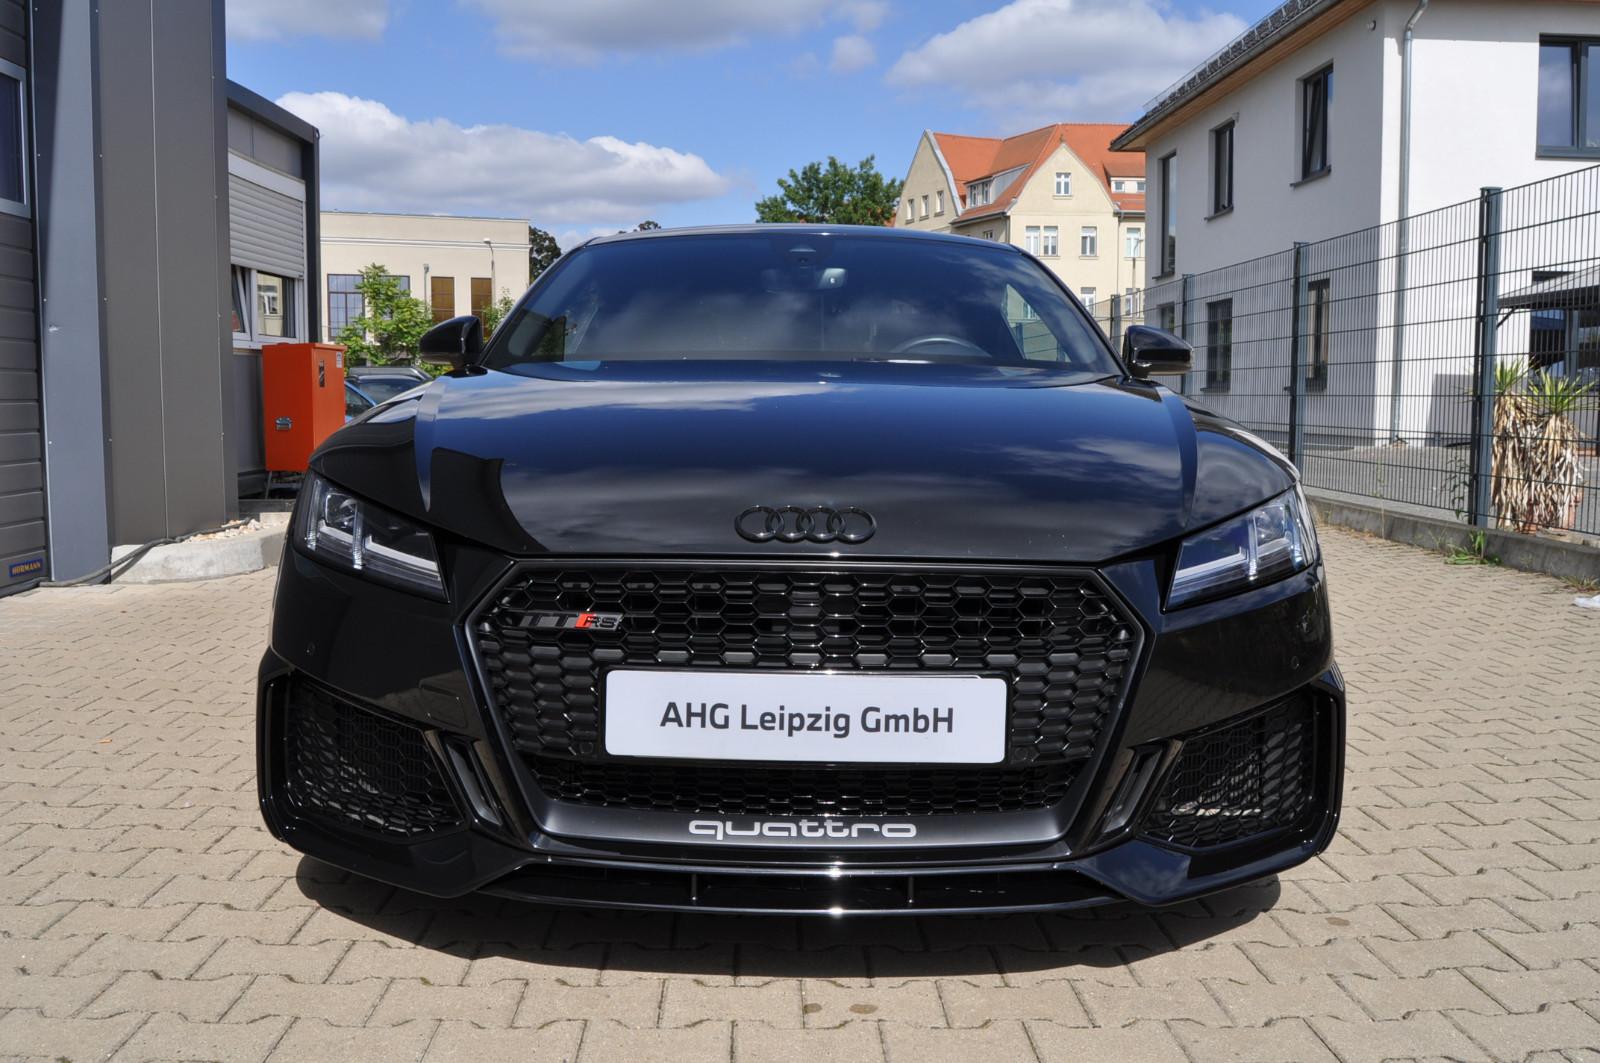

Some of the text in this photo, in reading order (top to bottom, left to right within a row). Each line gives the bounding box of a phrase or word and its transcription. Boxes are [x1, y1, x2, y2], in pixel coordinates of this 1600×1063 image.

[660, 702, 954, 738] AHG Leipzig GmbH
[688, 818, 917, 840] quattro
